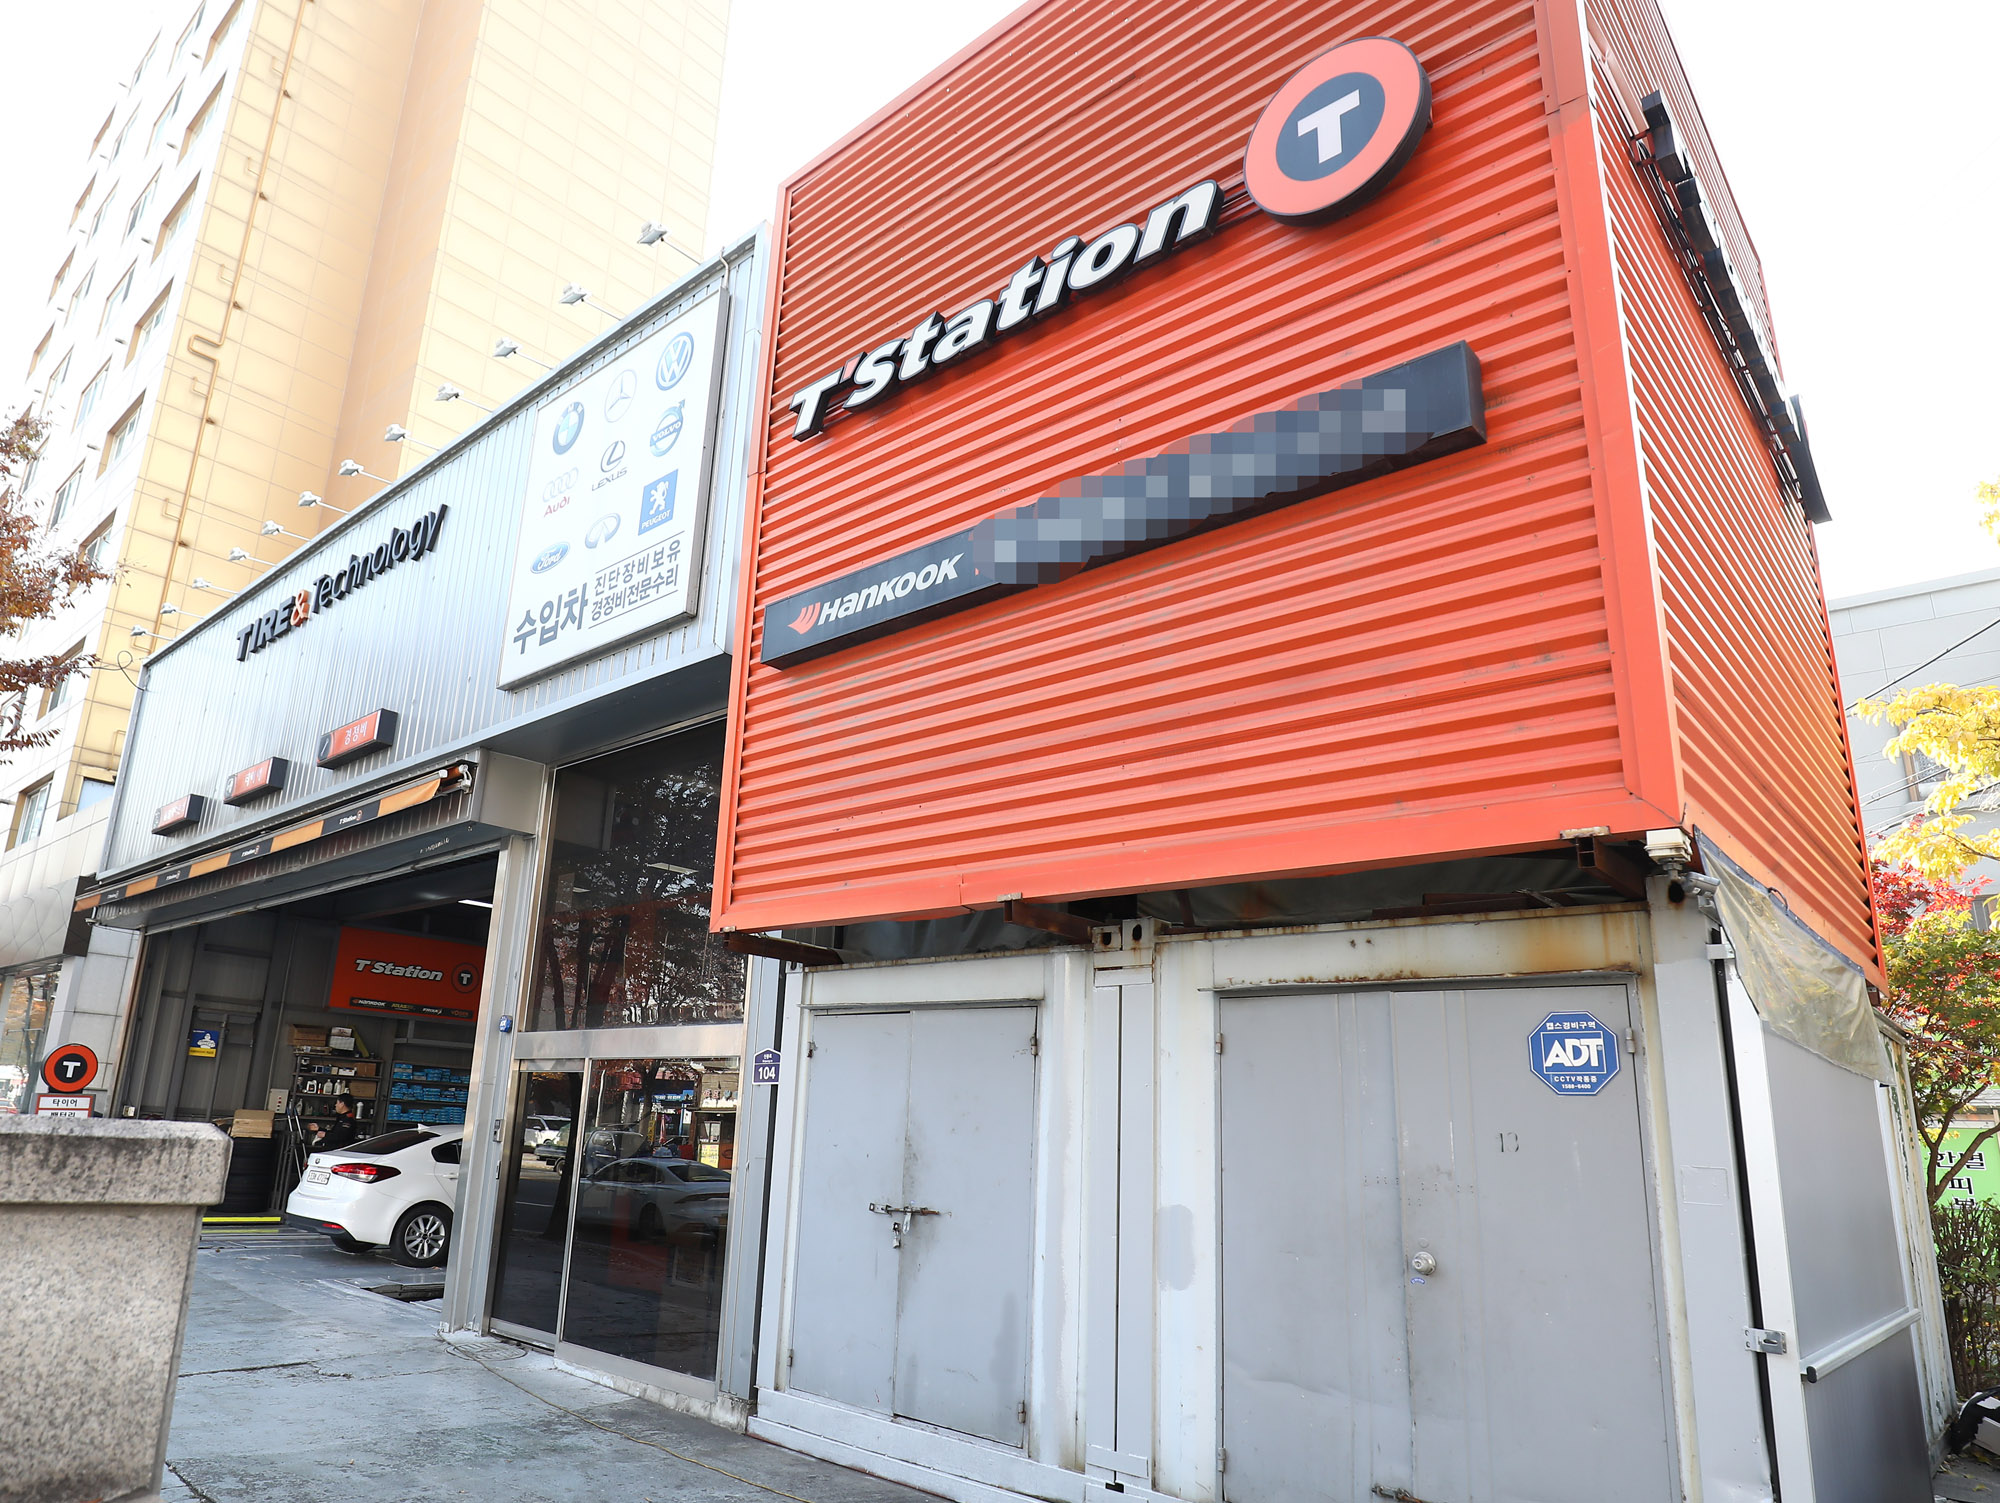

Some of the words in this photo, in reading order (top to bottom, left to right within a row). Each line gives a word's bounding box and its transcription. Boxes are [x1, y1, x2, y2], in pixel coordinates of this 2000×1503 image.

[1297, 89, 1361, 165] T
[652, 421, 682, 442] VOLVO
[592, 467, 627, 491] LEXUS
[544, 496, 570, 517] Audi
[641, 509, 672, 530] PEUGEOT
[312, 504, 448, 614] Technology
[537, 548, 562, 570] Ford
[513, 582, 588, 655] 수입차
[460, 973, 471, 985] T
[1545, 1038, 1603, 1067] ADT
[63, 1061, 81, 1078] T
[758, 1066, 776, 1080] 104
[52, 1098, 78, 1107] 타이어
